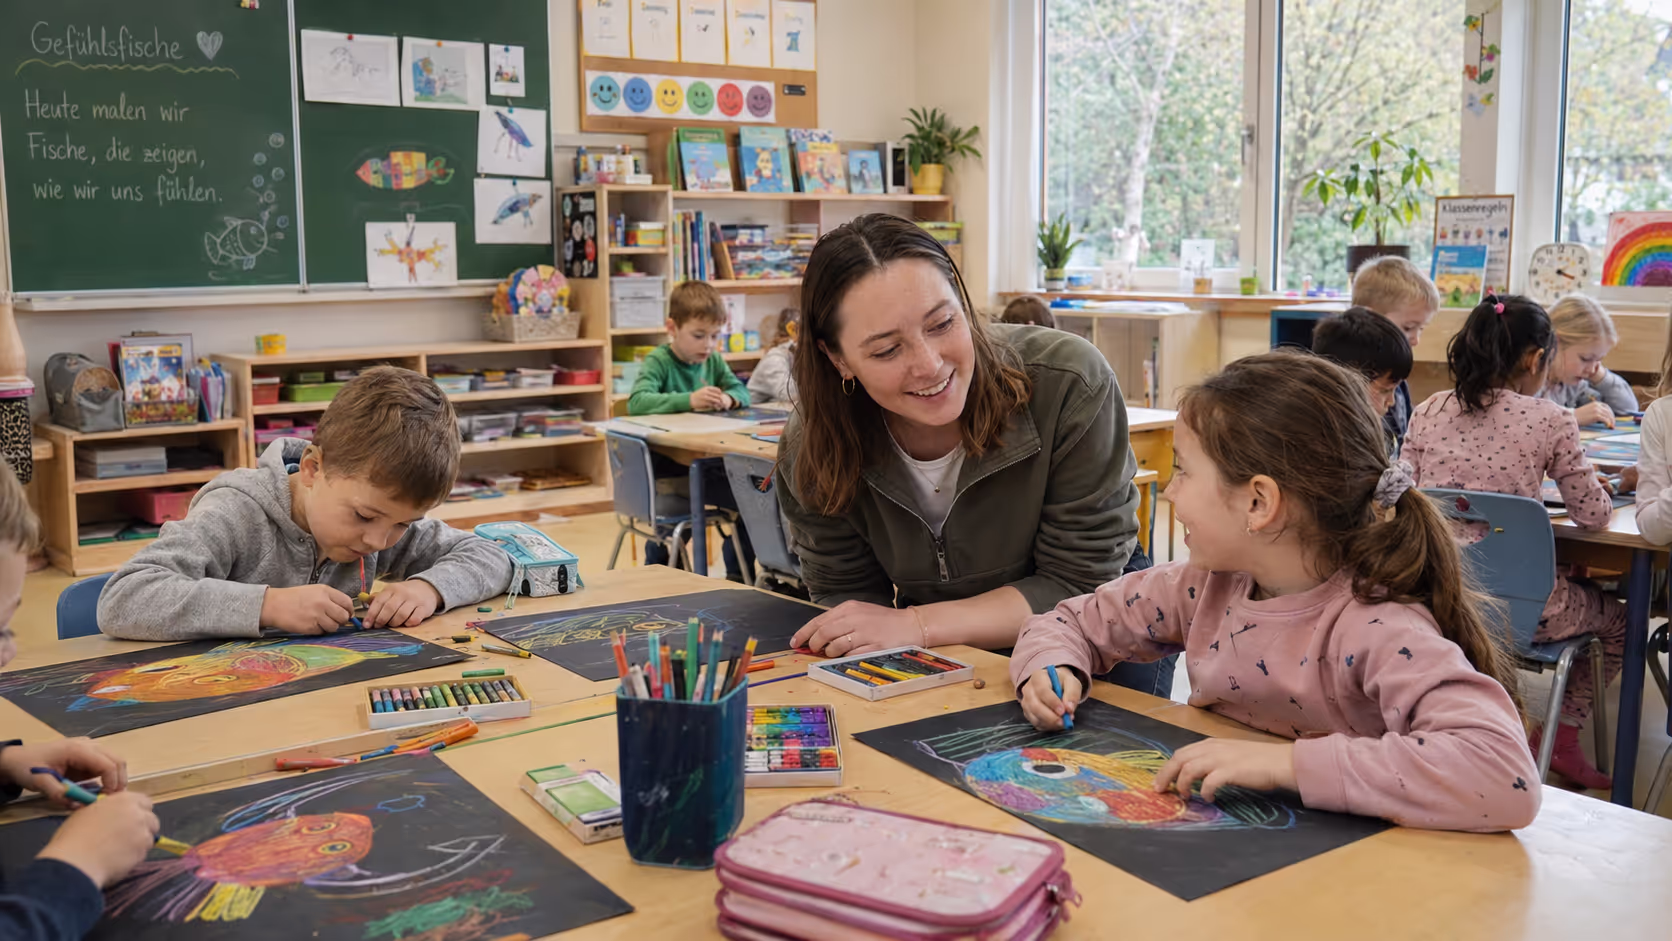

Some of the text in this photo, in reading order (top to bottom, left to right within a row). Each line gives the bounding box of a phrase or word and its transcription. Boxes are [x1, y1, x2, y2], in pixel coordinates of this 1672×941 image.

[31, 21, 183, 62] Gefühlsfische
[25, 89, 189, 122] Heute malen wir
[26, 132, 205, 174] Fische, die zeigen,
[33, 174, 223, 207] wie wir uns fühlen.
[1442, 201, 1507, 218] Klassenregeln
